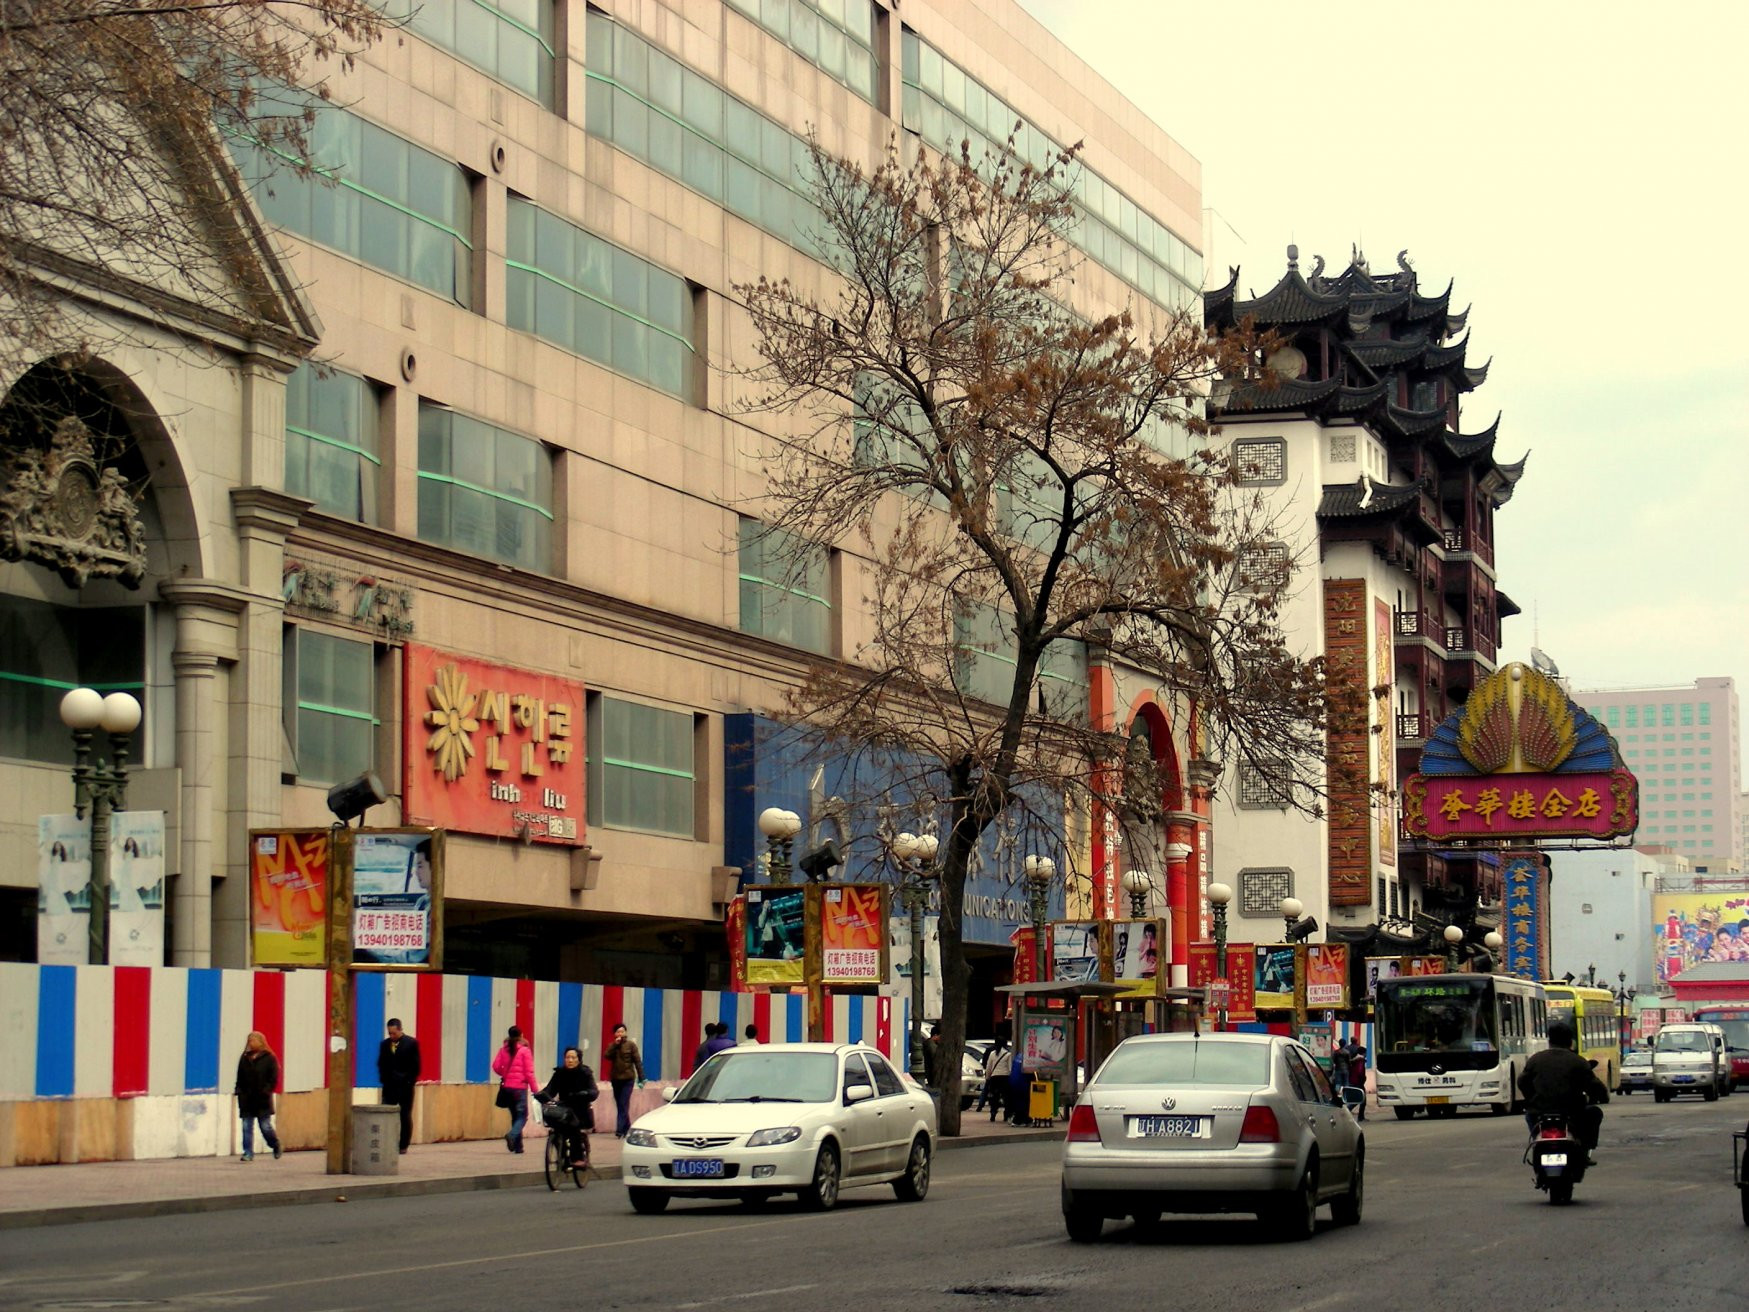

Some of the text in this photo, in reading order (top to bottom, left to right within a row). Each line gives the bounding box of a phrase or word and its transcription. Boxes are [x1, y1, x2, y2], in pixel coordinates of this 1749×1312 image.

[477, 689, 573, 777] 신한류
[359, 913, 424, 930] 灯箱广告招商电话
[358, 934, 424, 947] 13940198768
[827, 952, 876, 965] 灯箱广告招商电话
[827, 967, 876, 976] 13940198768
